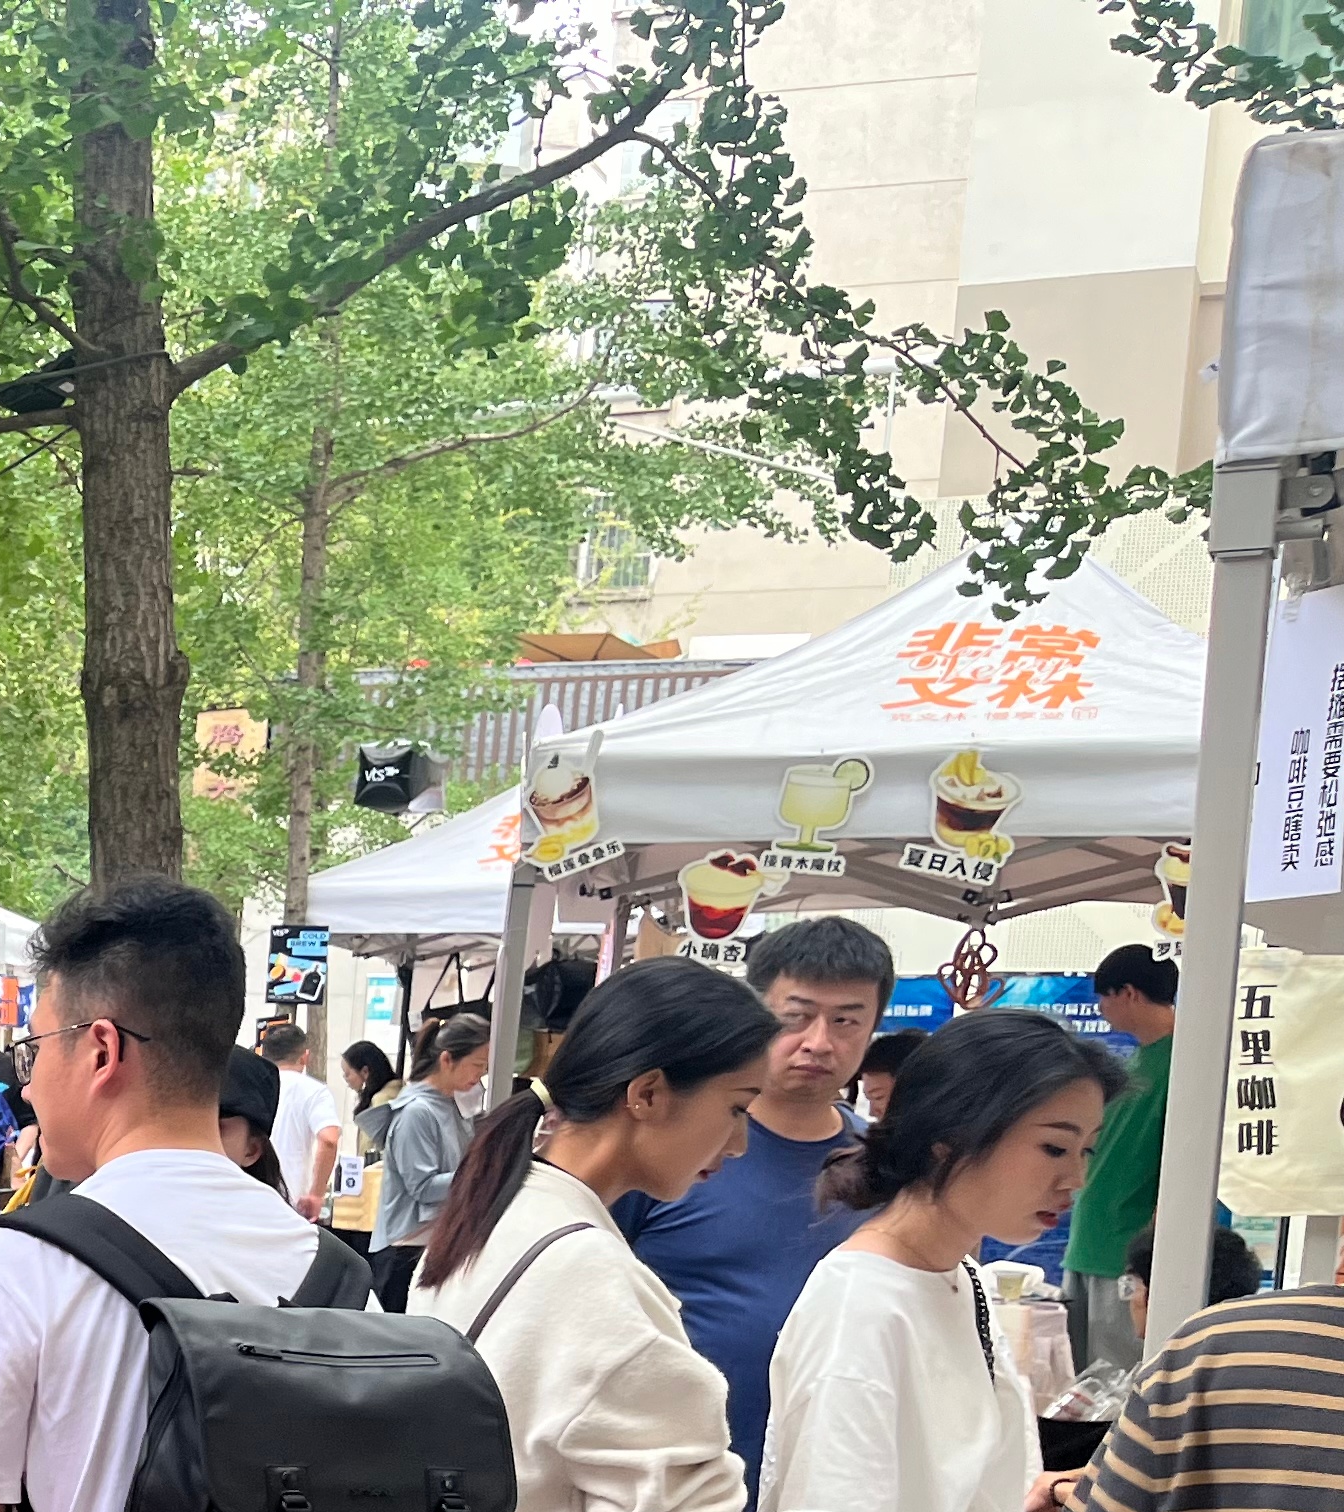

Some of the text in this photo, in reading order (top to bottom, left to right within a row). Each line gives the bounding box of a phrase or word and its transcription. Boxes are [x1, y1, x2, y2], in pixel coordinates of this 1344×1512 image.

[895, 621, 1101, 659] 非常
[880, 670, 1095, 709] 文林
[905, 847, 995, 883] 夏日入侵
[1236, 983, 1280, 1157] 五里咖啡
